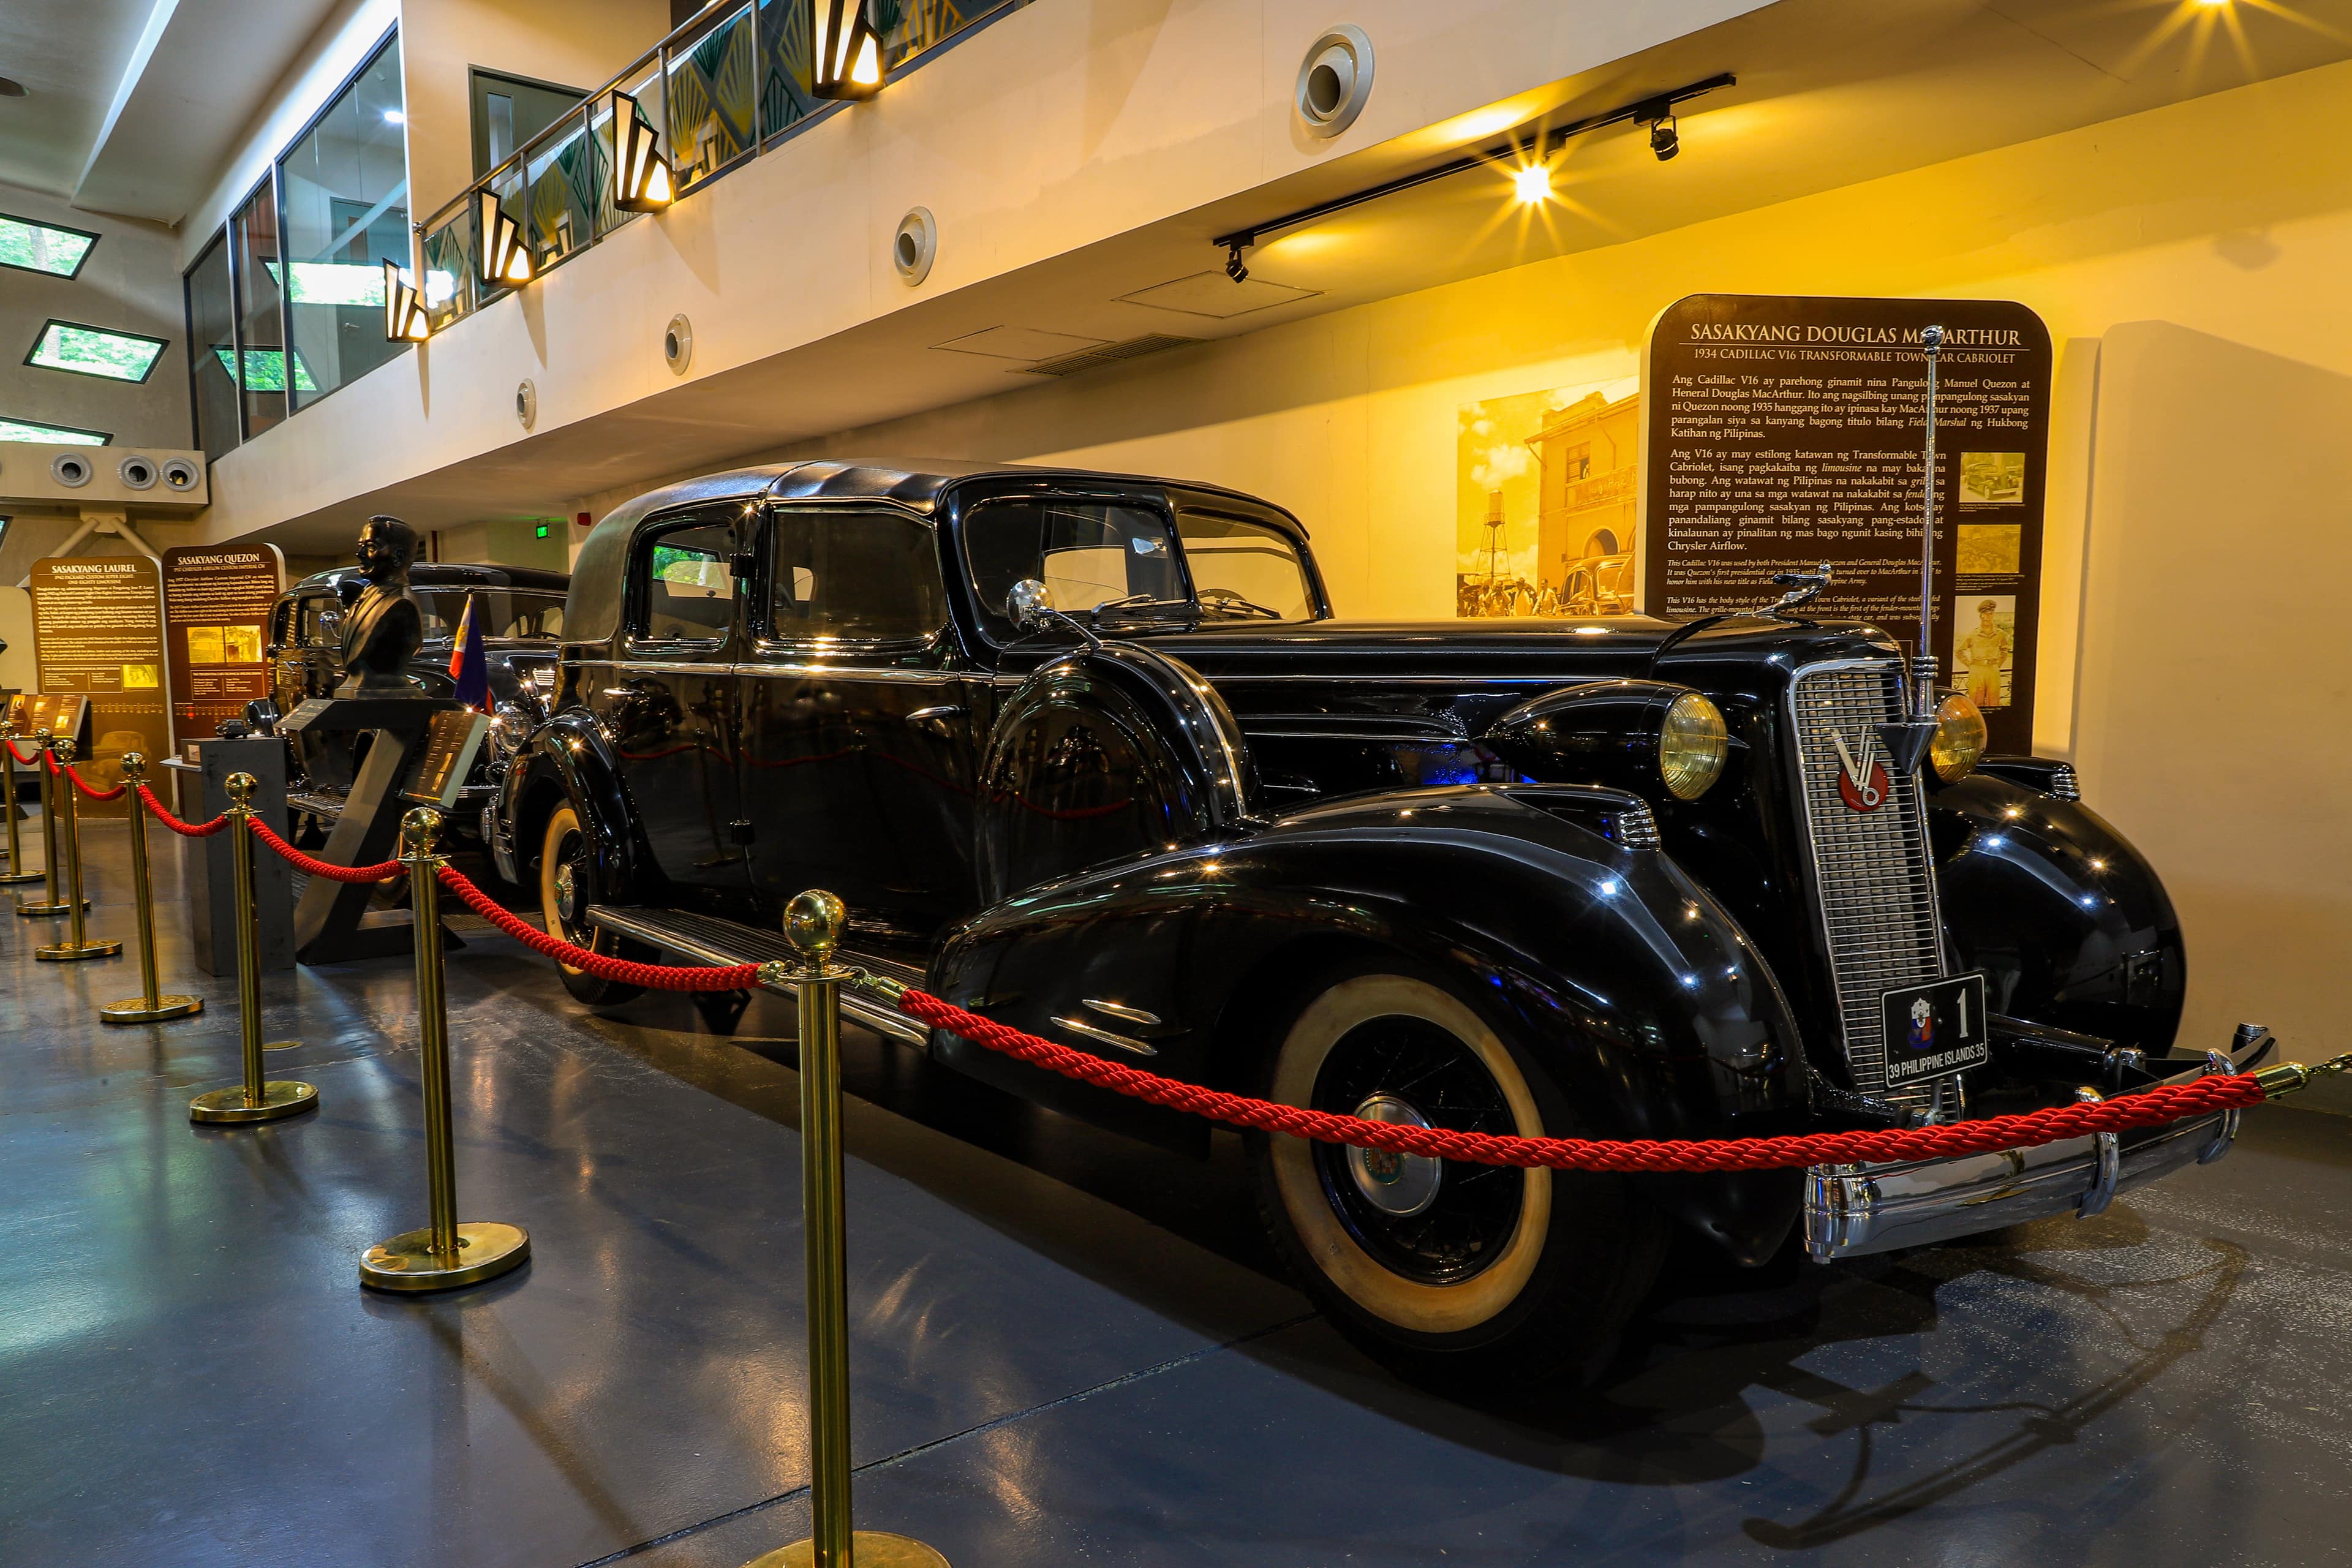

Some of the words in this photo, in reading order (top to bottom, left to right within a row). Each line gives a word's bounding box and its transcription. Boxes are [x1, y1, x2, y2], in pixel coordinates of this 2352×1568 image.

[1691, 323, 1800, 342] SASAKYANG
[1806, 326, 1896, 344] DOUGLAS
[1901, 328, 2022, 345] MARTHUR
[1695, 349, 1716, 358] 1934
[1720, 349, 1775, 359] CADILLAC
[1778, 350, 1796, 360] V16
[1798, 350, 1891, 361] TRANSFORMABLE
[1956, 353, 2015, 363] CABRIOLET
[1672, 374, 1692, 386] Ang
[1697, 374, 1735, 384] Cadillac
[1741, 375, 1758, 384] V16
[1763, 378, 1774, 388] ay
[1779, 376, 1822, 388] parehong
[1827, 377, 1862, 388] ginamit
[1867, 377, 1887, 386] nina
[1891, 377, 1939, 391] Pangulog
[1944, 379, 1977, 387] Manuel
[1982, 379, 2016, 389] Quezon
[1672, 388, 1708, 397] Heneral
[1711, 388, 1749, 401] Douglas
[1752, 389, 1804, 398] MacArthur.
[1807, 390, 1820, 398] Ito
[1822, 392, 1839, 402] ang
[1841, 390, 1888, 402] nagsilbing
[1890, 393, 1918, 402] unang
[1921, 391, 1988, 403] pmpangulong
[1989, 392, 2029, 404] sasakyan
[1672, 401, 1681, 410] ni
[1683, 401, 1719, 412] Quezon
[1721, 404, 1750, 414] noong
[1752, 402, 1772, 411] 1935
[1774, 402, 1819, 415] hanggang
[1820, 403, 1833, 412] ito
[1834, 405, 1845, 415] ay
[1847, 404, 1879, 415] ipinasa
[1881, 404, 1898, 415] kay
[1950, 407, 1978, 417] noong
[1980, 405, 1999, 413] 1937
[2001, 407, 2029, 417] upang
[1671, 415, 1722, 426] parangalan
[1727, 415, 1746, 428] siya
[1765, 415, 1804, 428] kanyang
[1809, 416, 1842, 428] bagong
[1847, 417, 1871, 425] titulo
[1875, 417, 1904, 429] bilang
[1970, 420, 1982, 429] ng
[1987, 418, 2028, 429] Hukbong
[1671, 428, 1707, 437] Katihan
[1709, 431, 1721, 440] ng
[1724, 428, 1765, 440] Pilipinas.
[1670, 448, 1691, 461] Ang
[1694, 448, 1712, 458] V16
[1716, 451, 1727, 461] ay
[1731, 451, 1751, 461] may
[1755, 449, 1791, 461] estilong
[1795, 449, 1833, 458] katawan
[1837, 452, 1849, 461] ng
[1852, 450, 1917, 459] Transformable
[1670, 462, 1714, 472] Cabriolet,
[1719, 462, 1744, 474] isang
[1748, 462, 1800, 474] pagkakaiba
[1805, 465, 1817, 474] ng
[1822, 462, 1862, 472] limousine
[1882, 466, 1901, 475] may
[1670, 475, 1706, 487] bubong.
[1711, 475, 1731, 487] Ang
[1777, 478, 1789, 488] ng
[1793, 475, 1832, 487] Pilipinas
[1850, 476, 1894, 485] nakakabit
[1669, 488, 1696, 500] harap
[1699, 489, 1717, 497] nito
[1720, 491, 1731, 500] ay
[1768, 491, 1787, 500] mga
[1846, 489, 1890, 497] nakakabit
[1934, 492, 1944, 500] ng
[1668, 504, 1689, 513] mga
[1695, 502, 1764, 513] pampangulong
[1769, 502, 1810, 513] sasakyan
[1815, 504, 1828, 513] ng
[1833, 502, 1874, 513] Pilipinas.
[1880, 502, 1899, 513] Ang
[1934, 505, 1943, 513] ay
[1668, 514, 1731, 526] panandaliang
[1738, 515, 1774, 526] ginamit
[1782, 514, 1809, 527] bilang
[1817, 514, 1863, 526] sasakyang
[1668, 527, 1719, 537] kinalaunan
[1722, 530, 1733, 540] ay
[1737, 528, 1776, 539] pinalitan
[1780, 530, 1792, 540] ng
[1817, 527, 1839, 539] bago
[1841, 528, 1871, 540] ngunit
[1874, 528, 1903, 539] kasing
[1667, 541, 1707, 552] Chrysler
[1709, 541, 1747, 549] Airflow.
[178, 556, 222, 565] SASAKYANG
[224, 554, 260, 565] QUEZON
[51, 565, 102, 573] SASAKYANG
[1957, 988, 1969, 1038] 1
[1889, 1063, 1900, 1079] 39
[1901, 1056, 1943, 1076] PHILIPPINE
[1945, 1047, 1975, 1065] ISLANDS
[1975, 1043, 1985, 1057] 35
